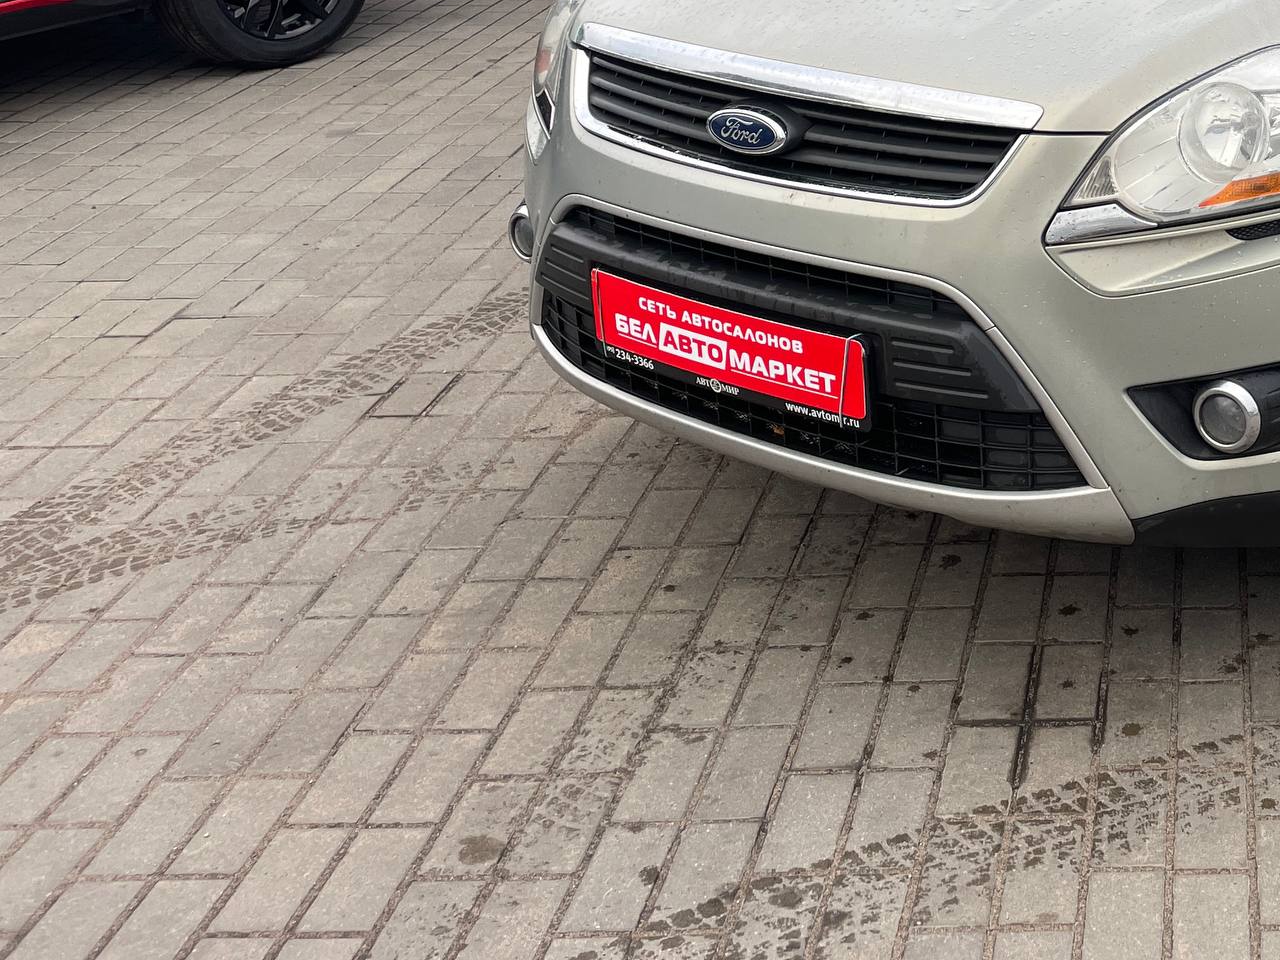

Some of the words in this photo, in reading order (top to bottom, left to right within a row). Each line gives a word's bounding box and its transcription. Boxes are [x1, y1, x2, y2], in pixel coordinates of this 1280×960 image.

[721, 117, 763, 144] Ford
[638, 296, 677, 320] СЕТЬ
[681, 310, 804, 353] АВТОСАЛОНОВ
[614, 312, 657, 344] БЕЛ
[662, 331, 723, 362] АВТО
[729, 348, 837, 394] МАРКЕТ
[615, 348, 655, 370] 234-3366
[784, 402, 860, 429] www.avtomr.ru
